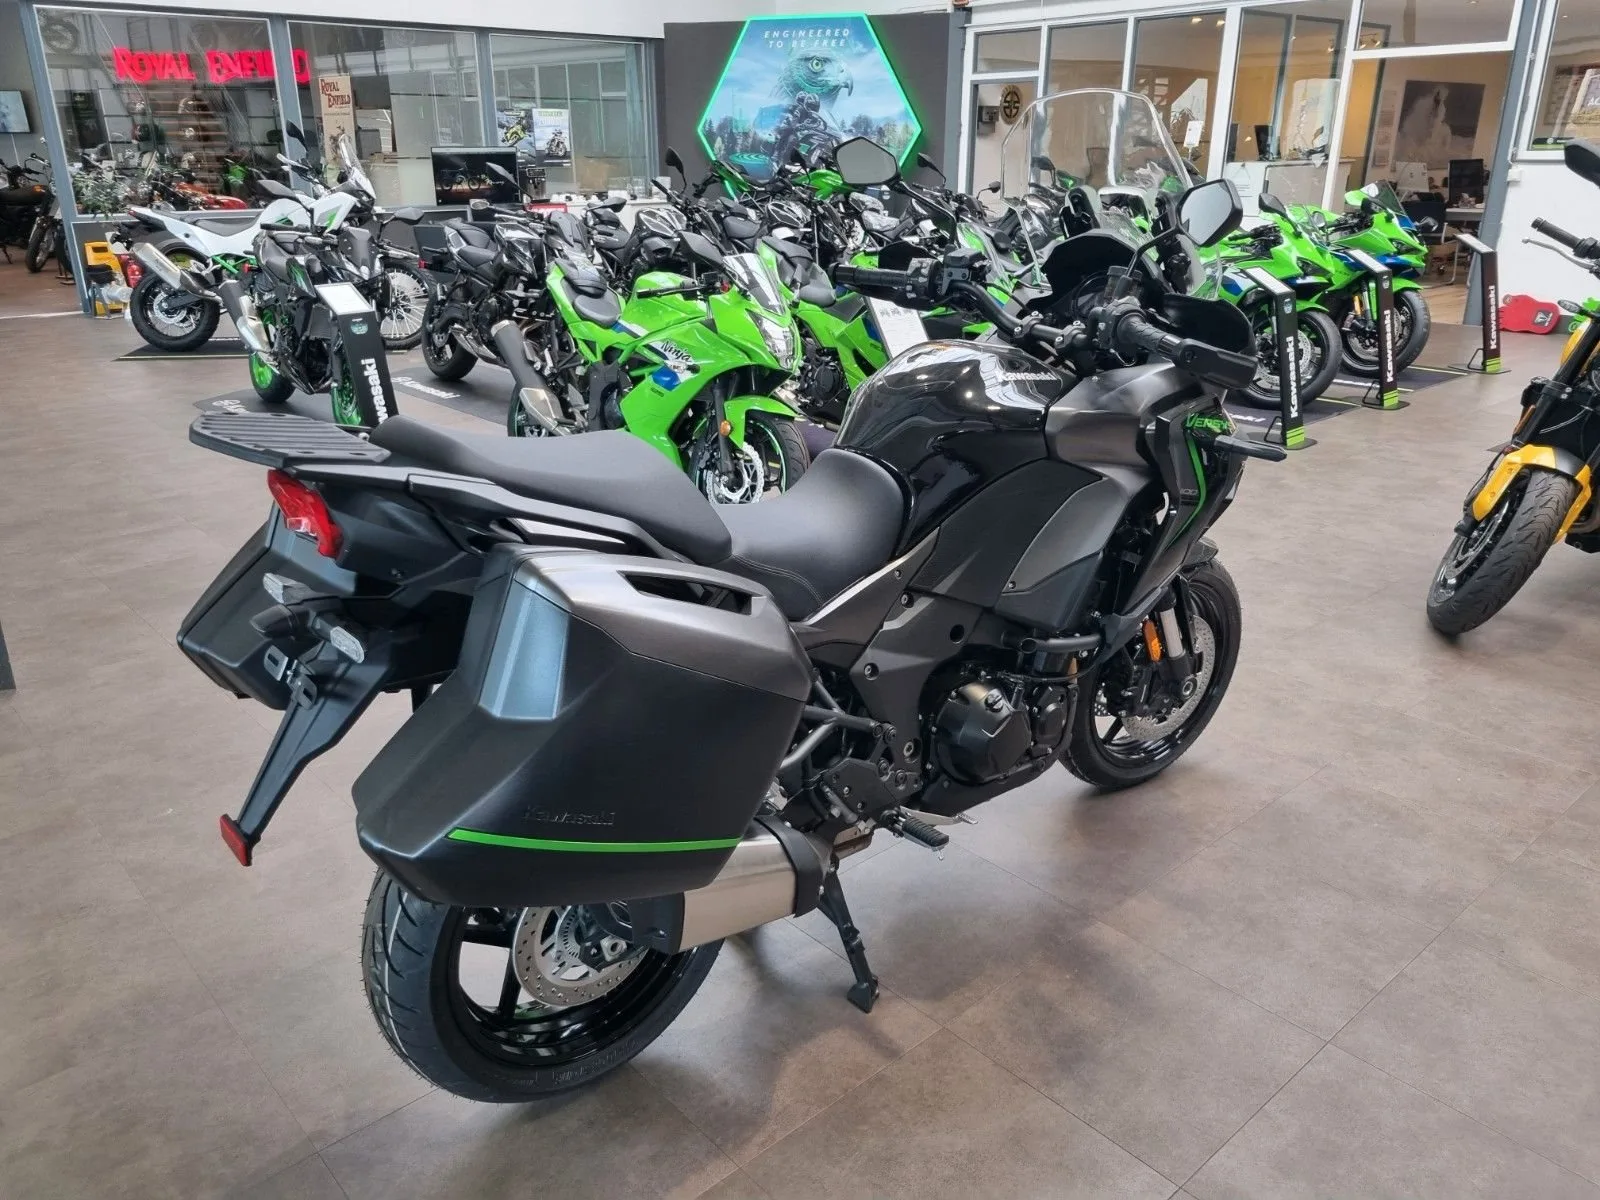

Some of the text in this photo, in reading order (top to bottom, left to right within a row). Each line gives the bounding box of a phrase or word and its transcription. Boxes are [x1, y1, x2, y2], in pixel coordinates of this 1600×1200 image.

[764, 28, 850, 38] ENGINEERED
[768, 38, 846, 48] TO BE FREE
[113, 46, 310, 84] ROYAL ENFID
[320, 79, 340, 95] ROYAL
[327, 94, 351, 108] ENFIELD
[1488, 285, 1497, 350] Kawasaki
[660, 340, 692, 362] Ninja
[1383, 310, 1394, 382] Kawasaki
[361, 358, 388, 424] wasaki
[1285, 336, 1299, 418] Kawasaki
